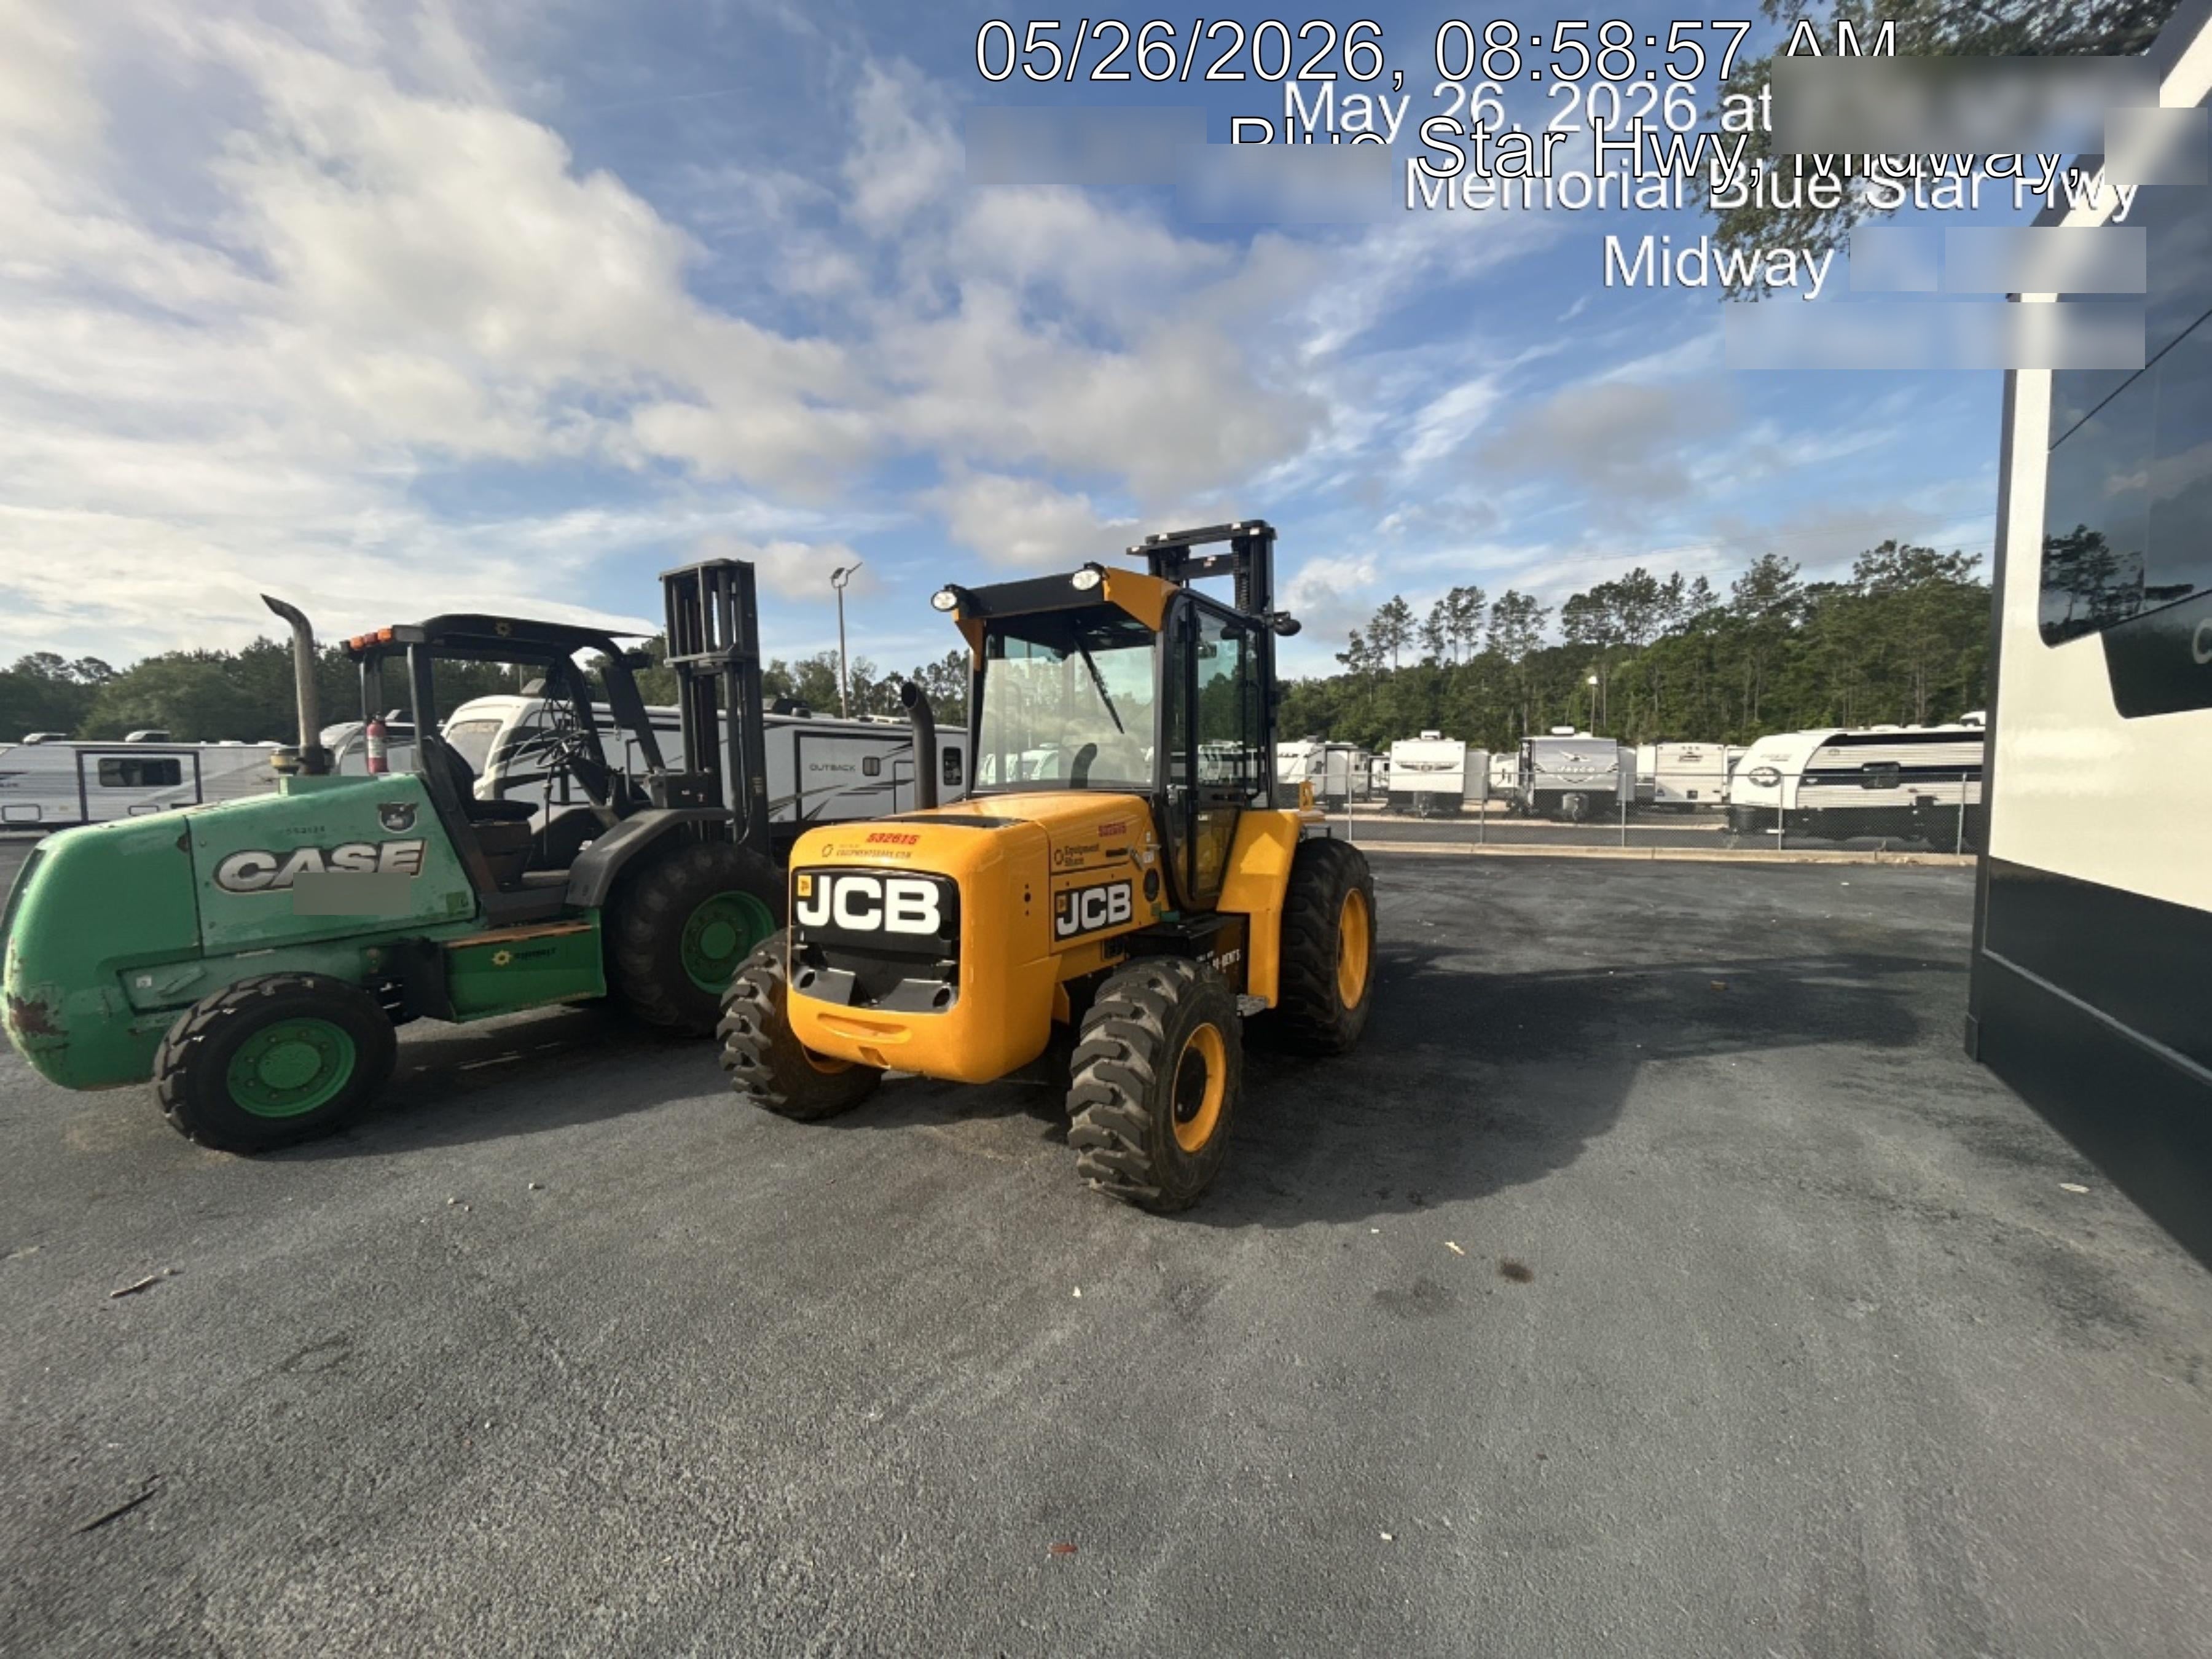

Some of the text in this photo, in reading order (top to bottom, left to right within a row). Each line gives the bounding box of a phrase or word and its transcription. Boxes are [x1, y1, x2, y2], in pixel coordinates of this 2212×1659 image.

[217, 839, 425, 891] CASE
[797, 875, 941, 935] JCB
[1057, 884, 1131, 935] JCB
